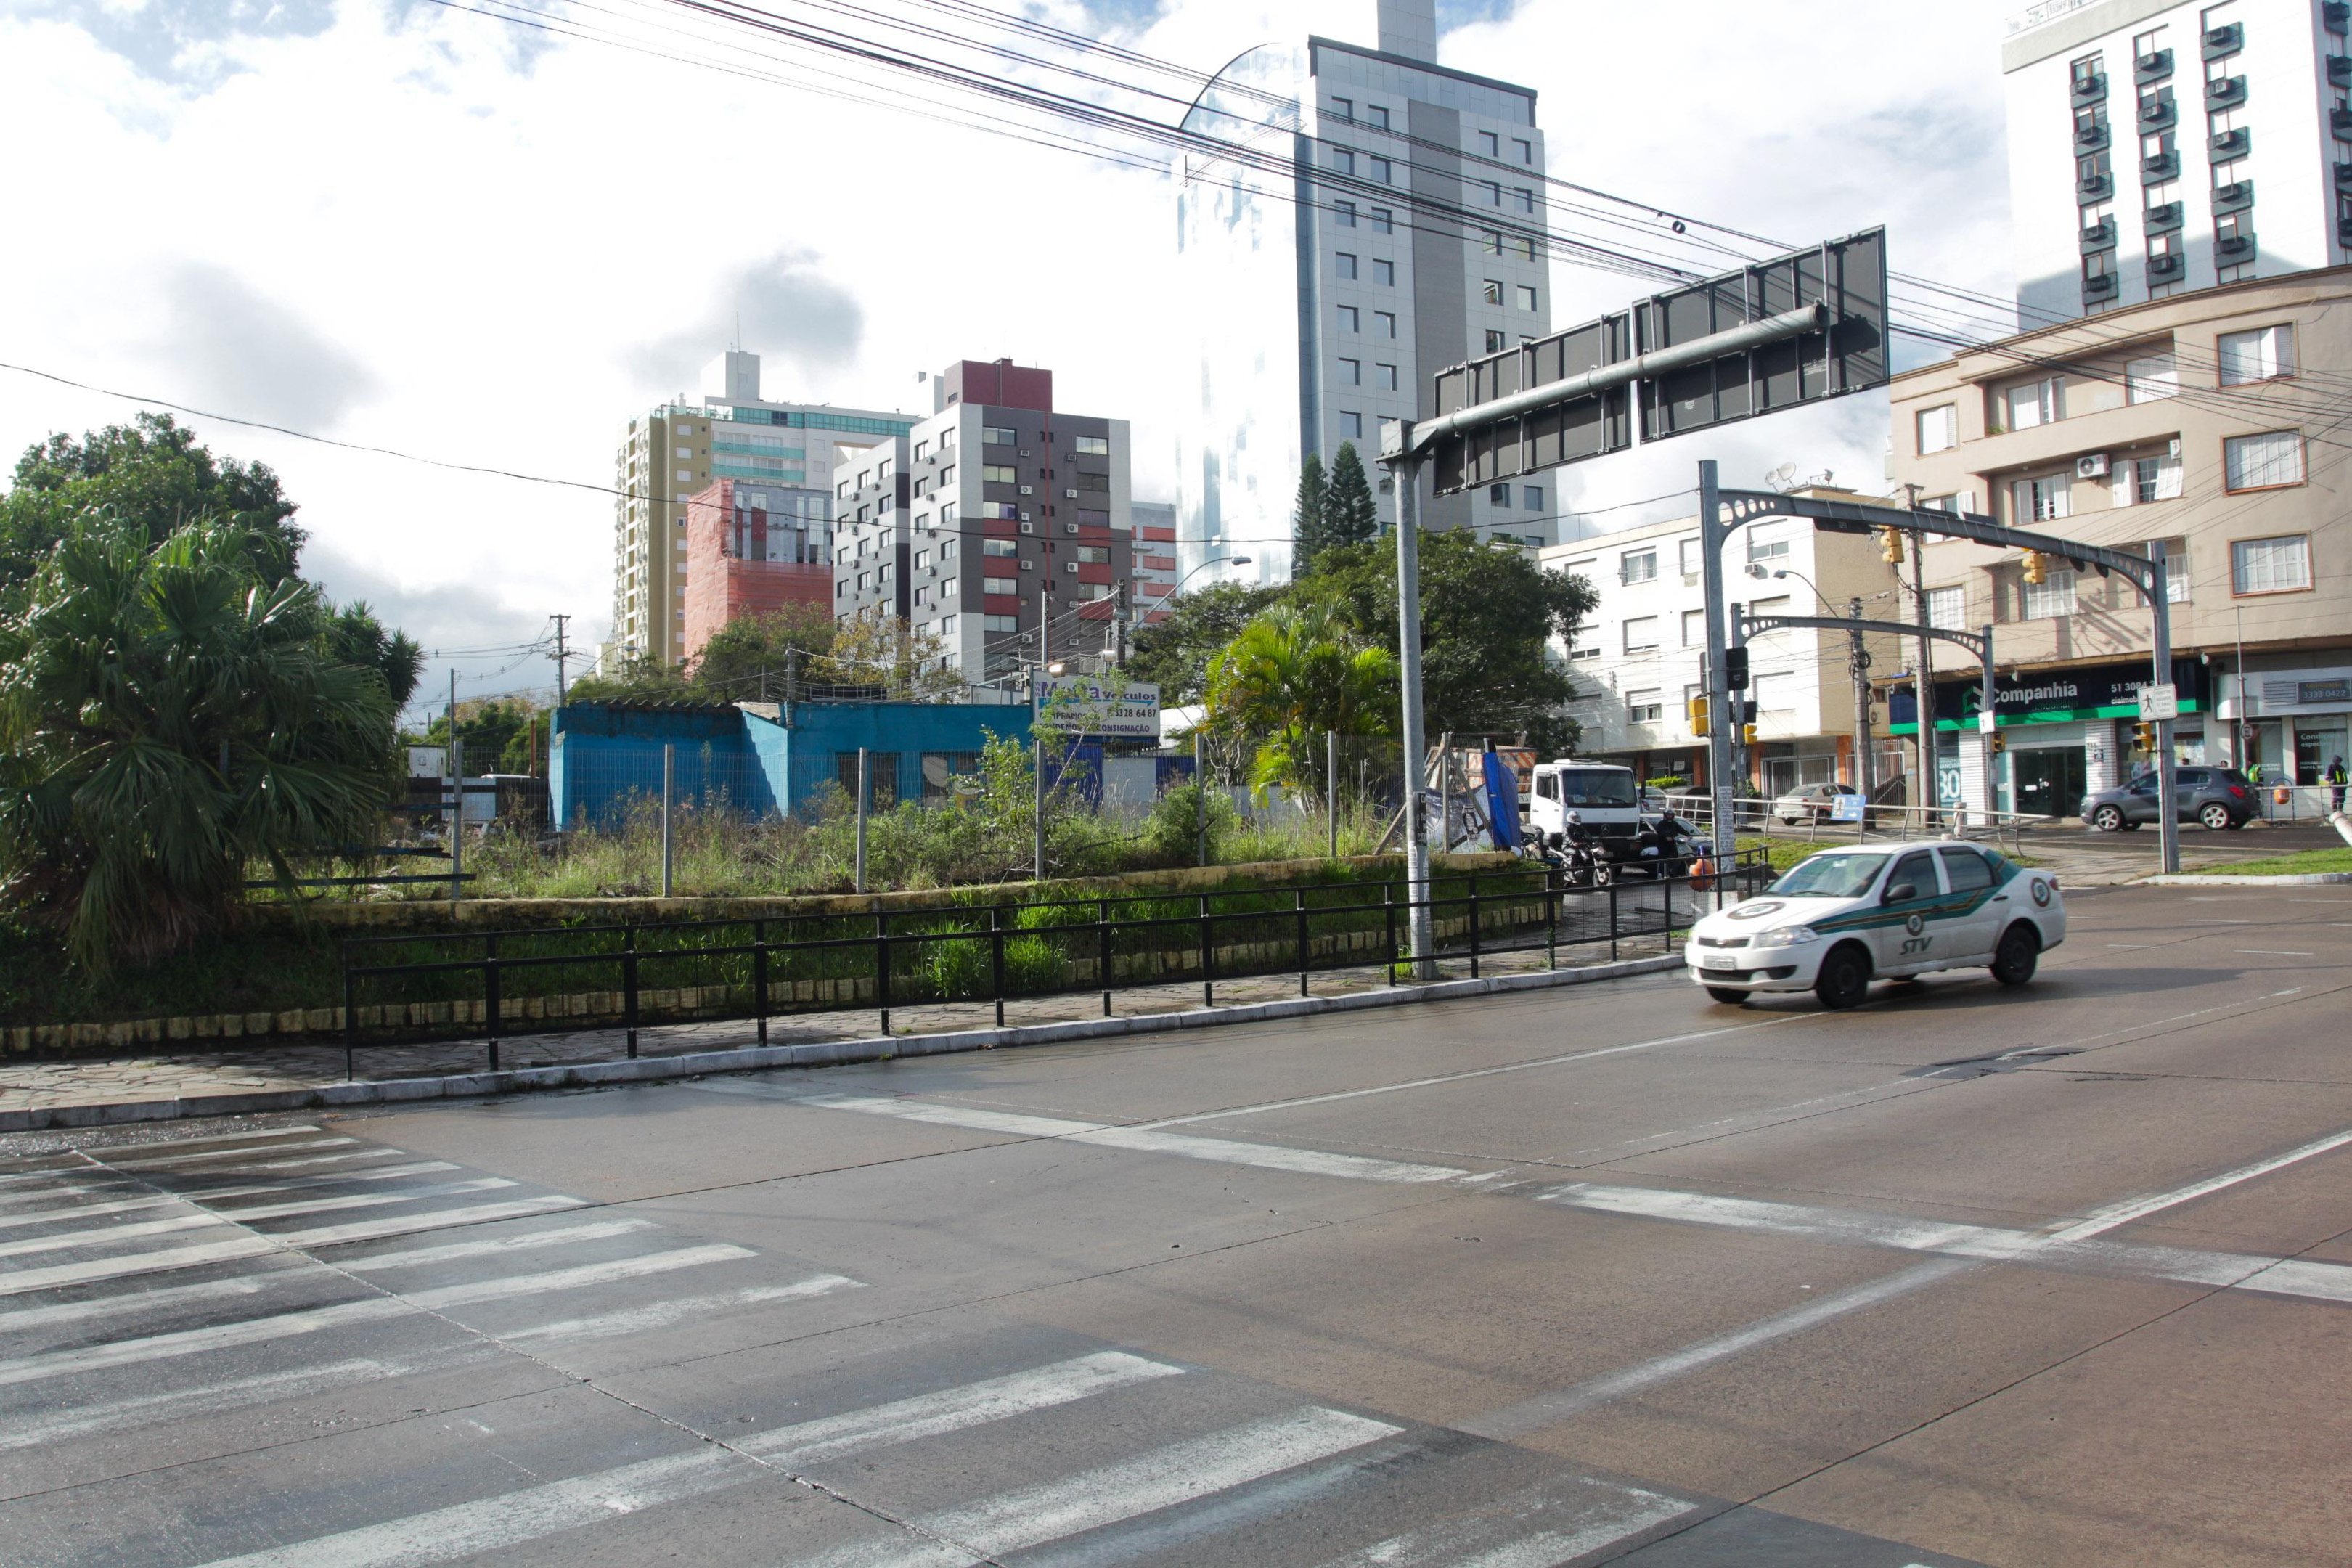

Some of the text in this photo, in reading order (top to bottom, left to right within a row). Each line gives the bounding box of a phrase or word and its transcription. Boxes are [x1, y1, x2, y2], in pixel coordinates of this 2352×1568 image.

[1993, 681, 2078, 704] Companhia
[2111, 684, 2122, 693] 51
[2125, 682, 2147, 691] 3084
[1900, 936, 1932, 955] STV
